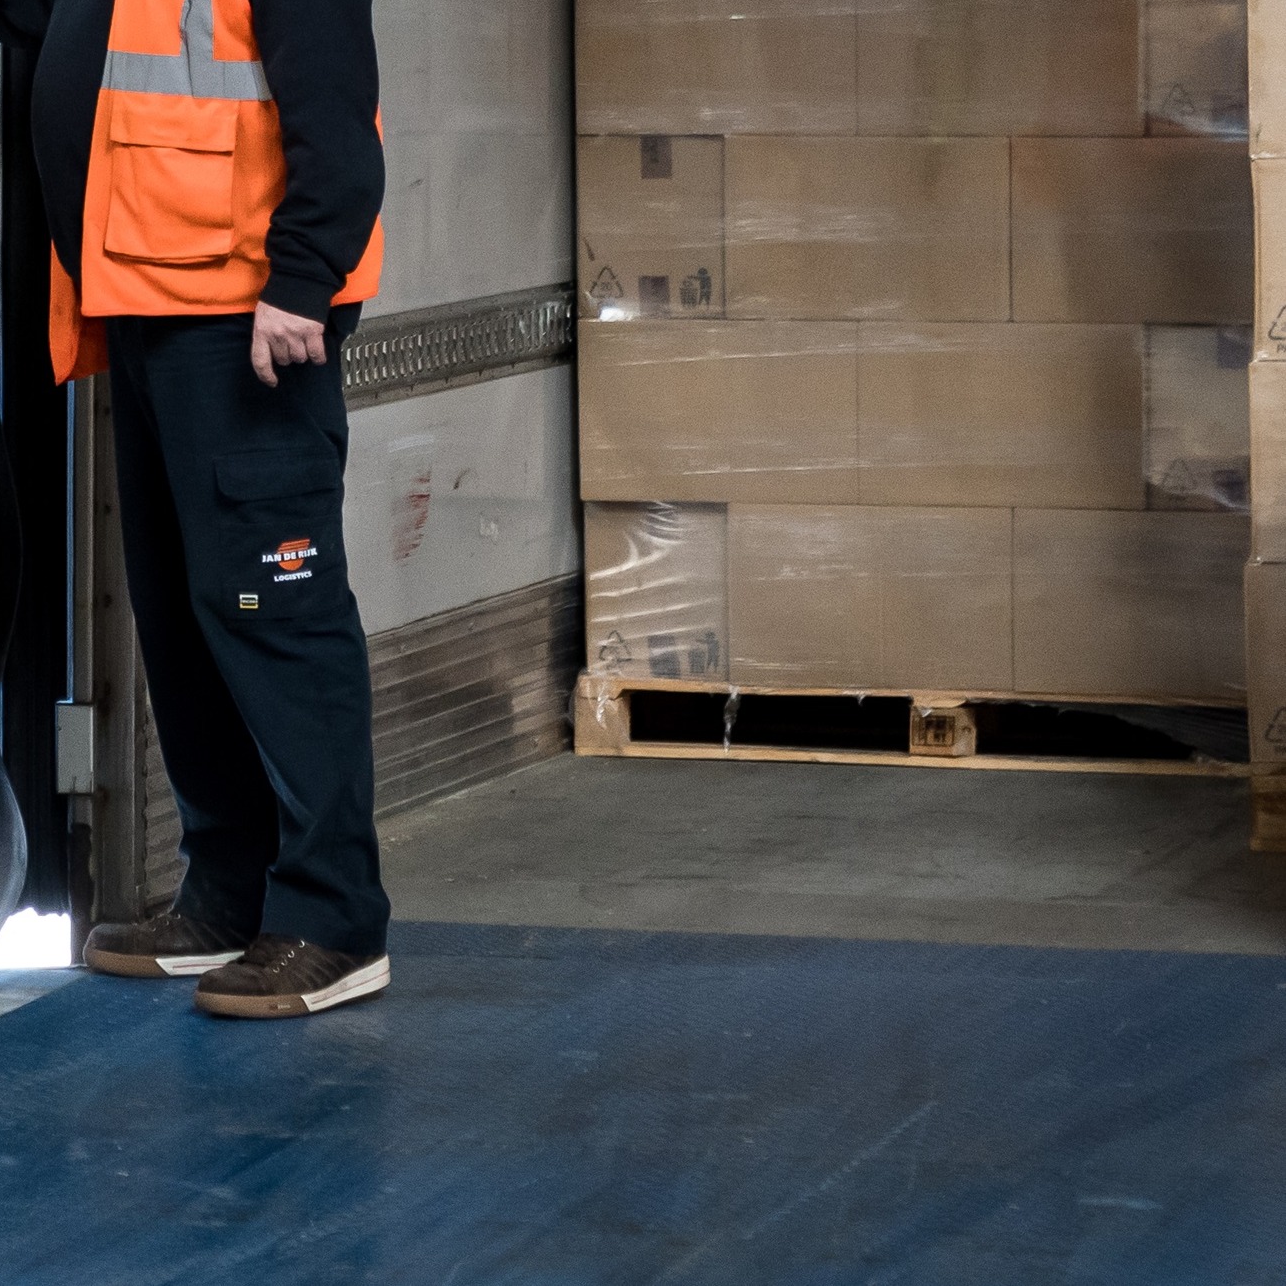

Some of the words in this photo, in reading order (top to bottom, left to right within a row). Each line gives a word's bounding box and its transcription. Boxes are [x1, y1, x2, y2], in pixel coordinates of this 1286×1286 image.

[262, 554, 282, 563] JAN
[283, 552, 297, 561] DE
[298, 547, 318, 559] RIJK
[273, 570, 313, 582] LOGISTICS
